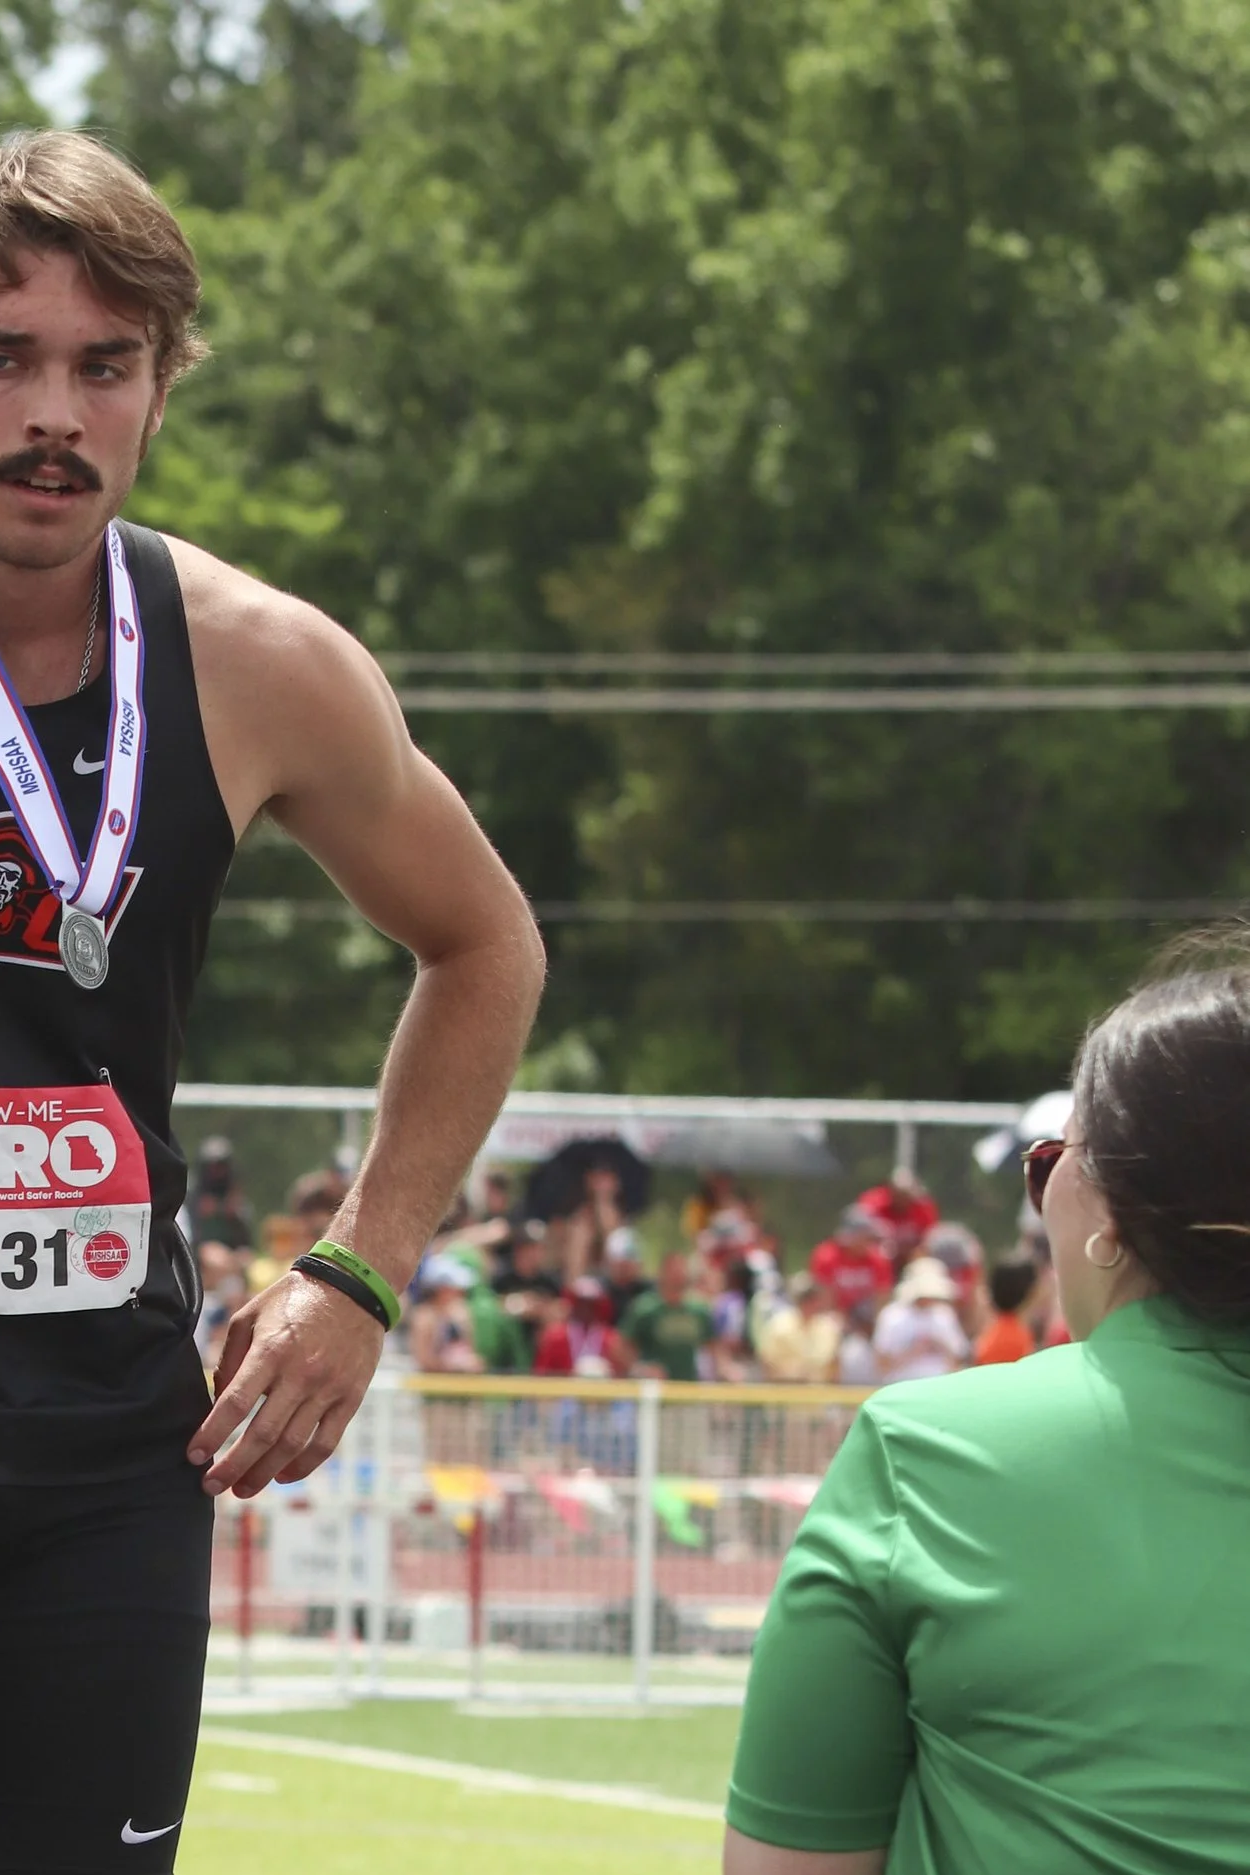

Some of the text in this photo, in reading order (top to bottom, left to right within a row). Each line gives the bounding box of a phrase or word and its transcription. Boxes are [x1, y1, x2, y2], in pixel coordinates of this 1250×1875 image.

[118, 697, 135, 757] MSHSAA
[0, 736, 40, 795] MSHSAA
[26, 1190, 53, 1200] Safer
[54, 1190, 84, 1200] Roads
[90, 1250, 122, 1262] MSHSAA
